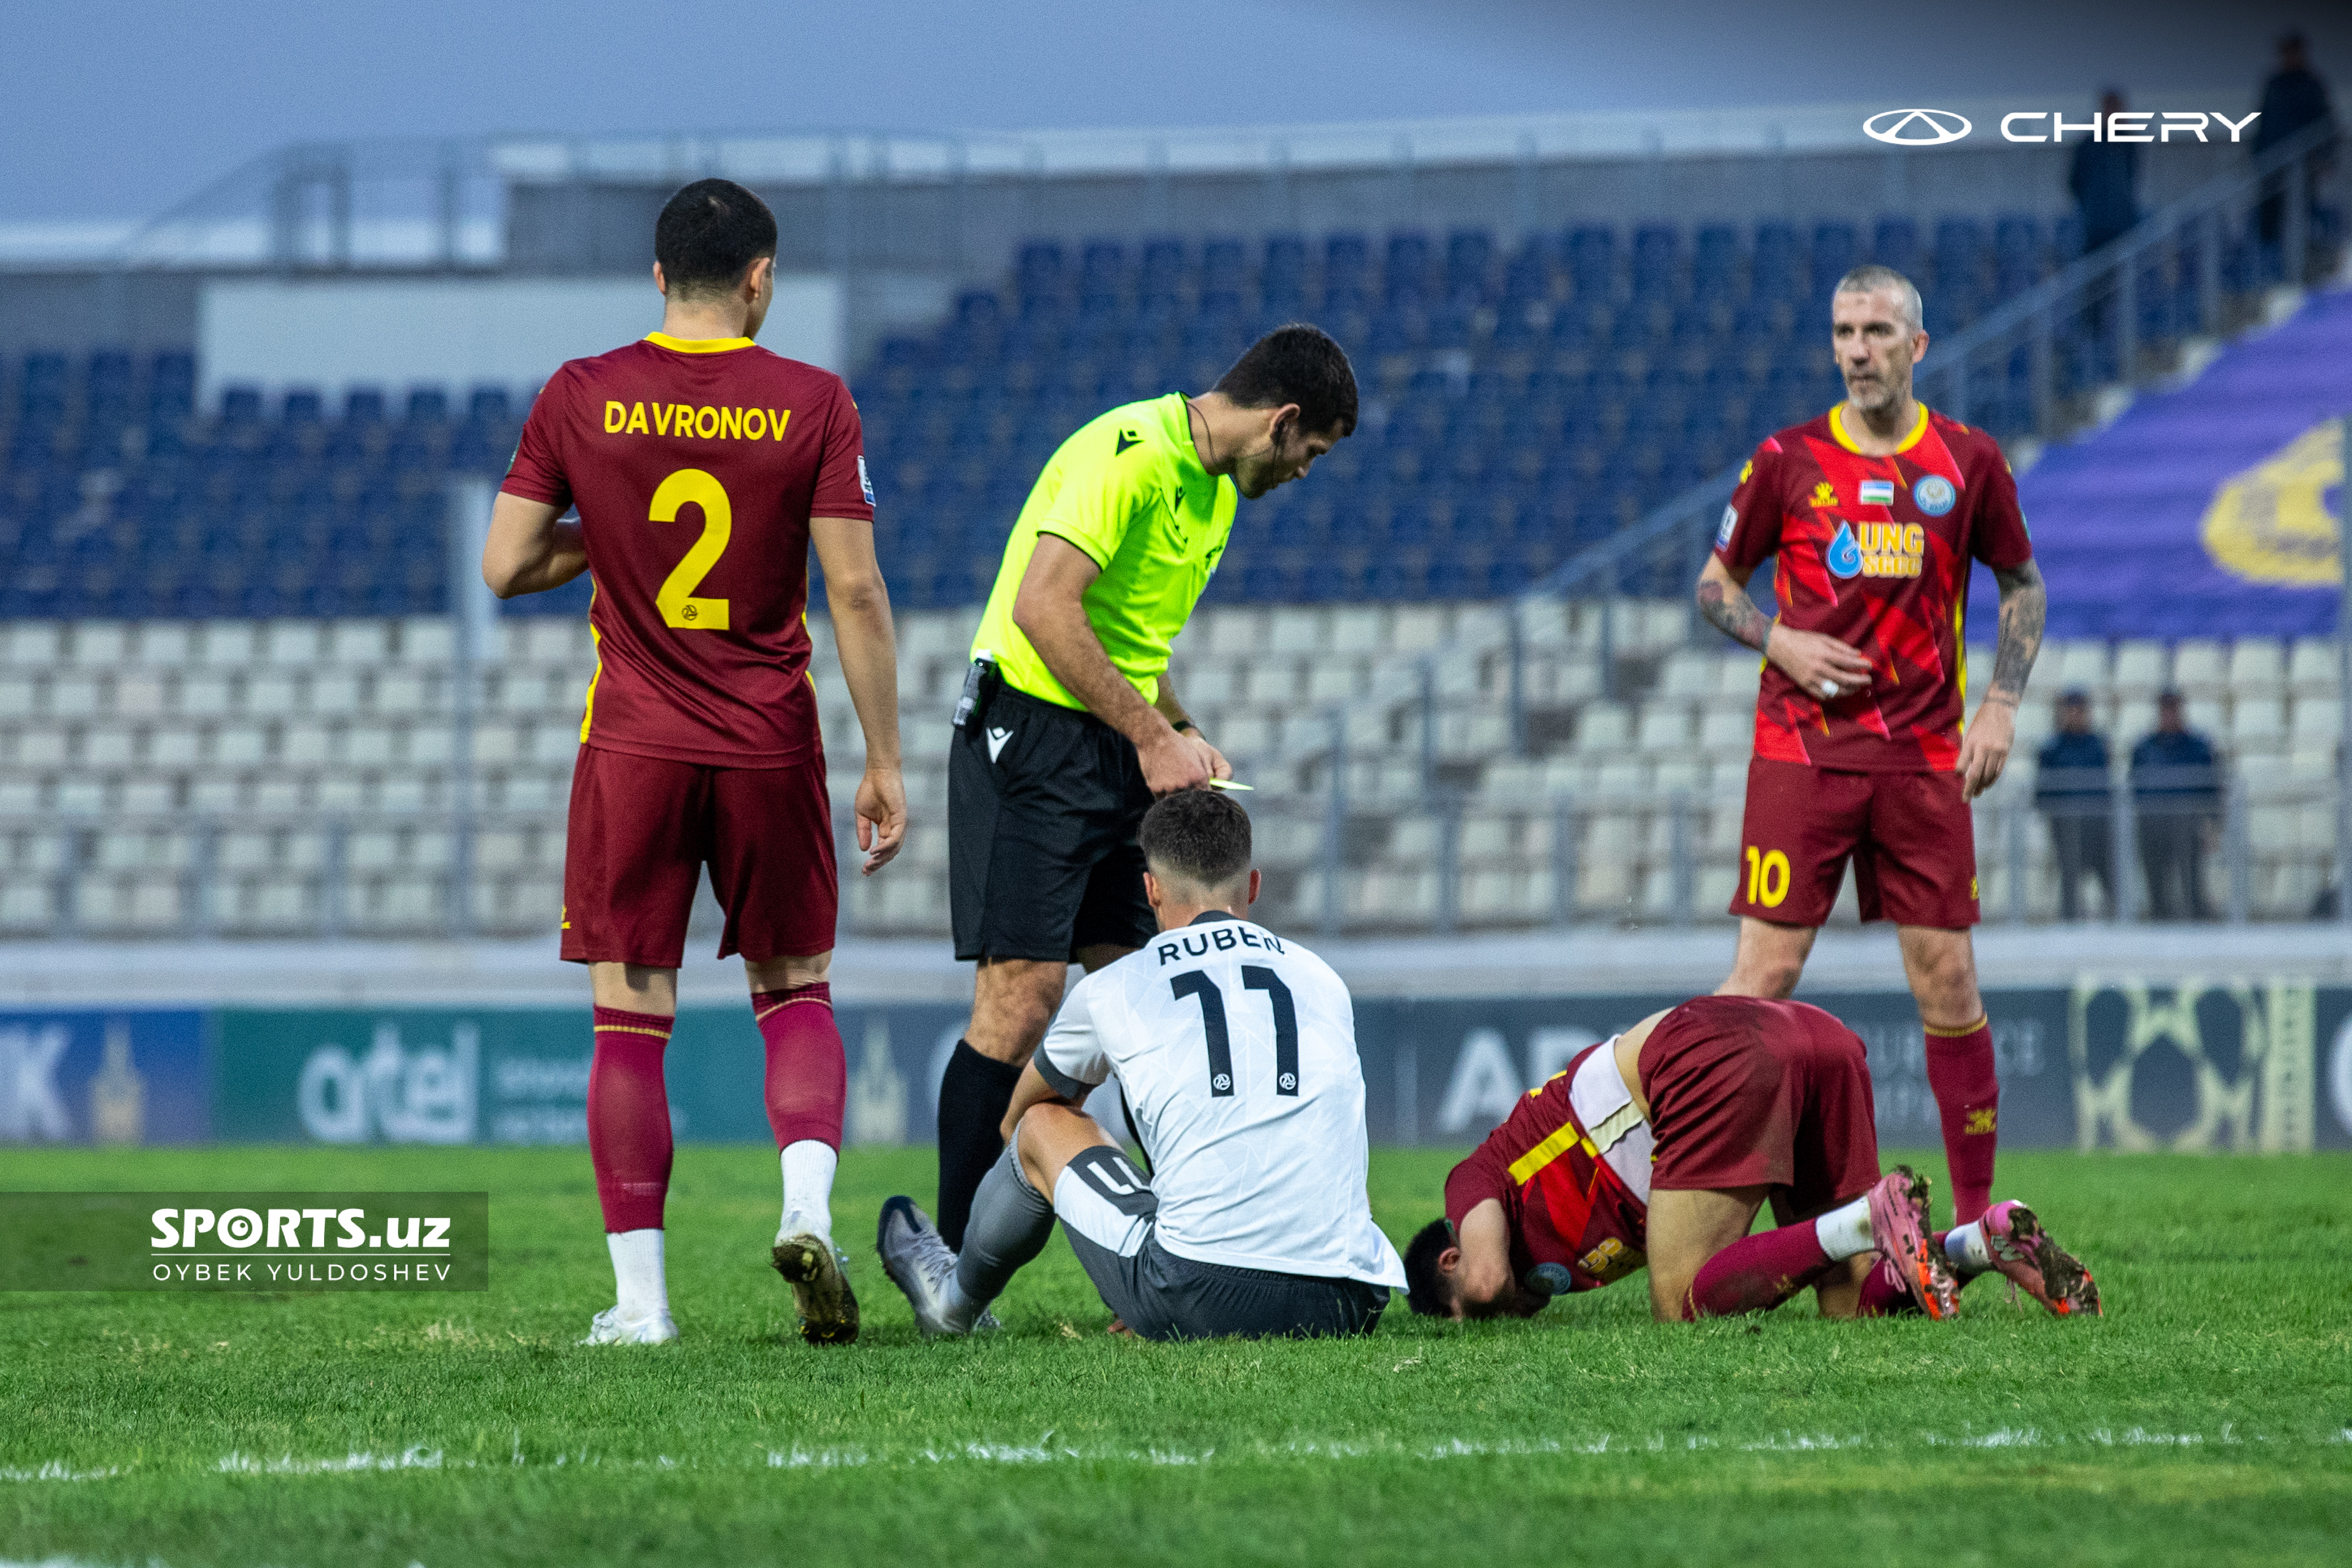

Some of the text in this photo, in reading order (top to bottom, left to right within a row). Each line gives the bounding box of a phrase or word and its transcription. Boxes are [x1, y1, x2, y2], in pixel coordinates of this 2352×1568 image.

[604, 400, 791, 441] DAVRONOV
[648, 468, 732, 630] 2
[1859, 521, 1925, 555] UNG
[1746, 845, 1791, 908] 10
[1158, 926, 1287, 966] RUBEN
[1170, 965, 1299, 1098] 11
